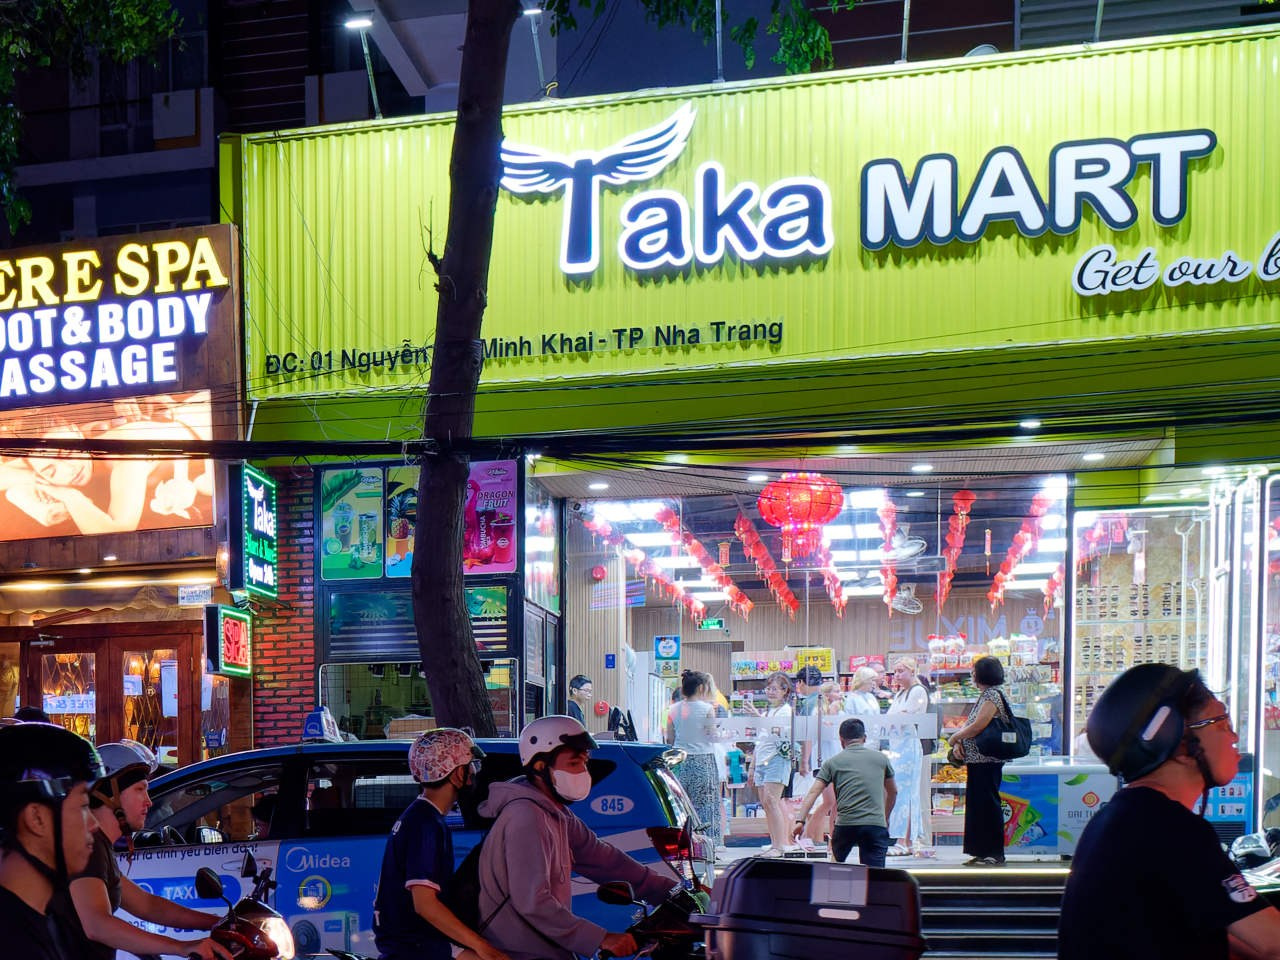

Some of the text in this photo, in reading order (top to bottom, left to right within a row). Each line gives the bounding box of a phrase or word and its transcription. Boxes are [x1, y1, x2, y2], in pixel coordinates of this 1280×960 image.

[510, 112, 1216, 274] Taka MART
[114, 237, 229, 296] SPA
[1074, 246, 1158, 293] Get
[1167, 253, 1249, 283] our
[310, 351, 334, 372] 01
[481, 335, 532, 360] Minh
[541, 330, 593, 355] Khai
[655, 324, 701, 347] Nha
[710, 320, 784, 344] Trang
[477, 490, 514, 500] DRAGON
[483, 499, 509, 509] FRUIT
[601, 798, 625, 812] 845
[289, 849, 351, 871] Midea
